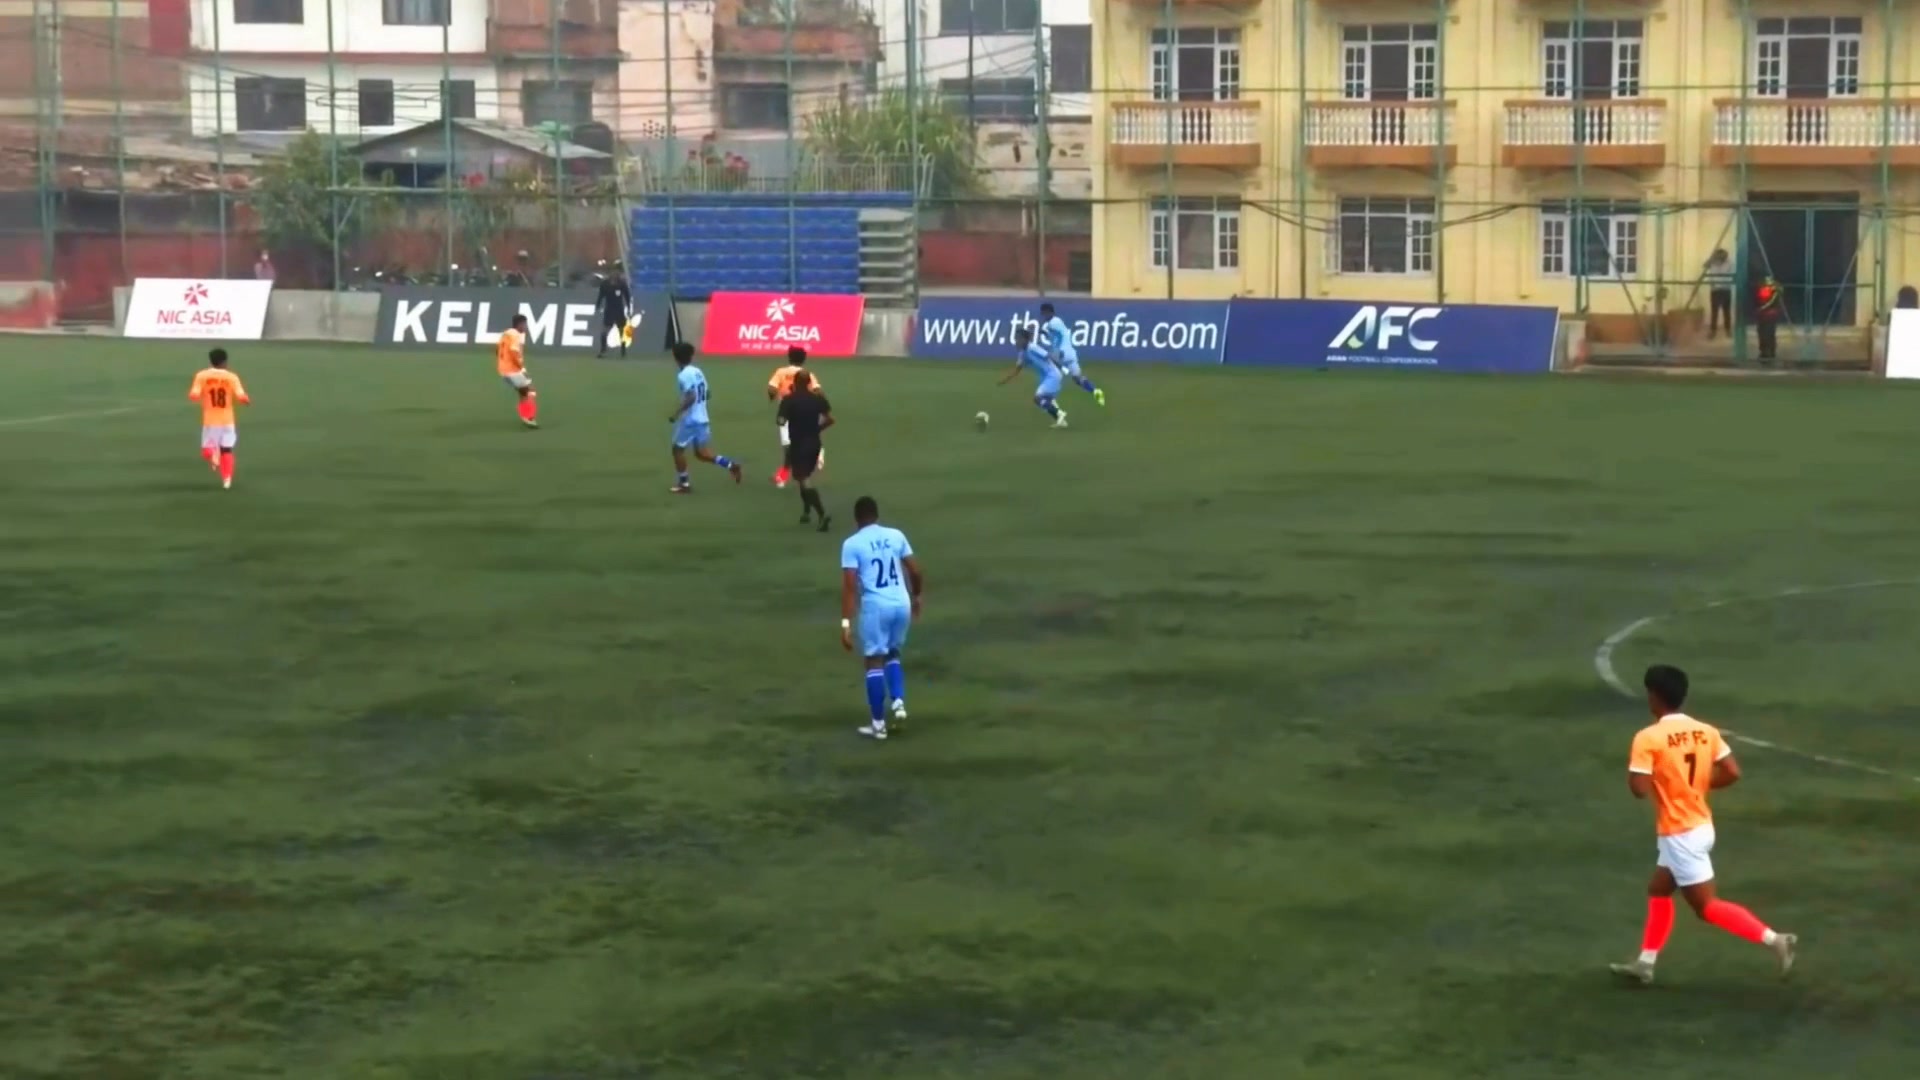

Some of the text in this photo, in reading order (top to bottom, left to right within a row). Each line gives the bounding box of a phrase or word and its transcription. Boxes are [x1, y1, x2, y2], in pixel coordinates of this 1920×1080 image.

[157, 309, 232, 325] NIC ASIA
[392, 299, 597, 348] KELME
[738, 324, 820, 342] NIC ASIA
[923, 310, 1218, 350] www.theanfa.com
[1327, 305, 1443, 351] AFC
[209, 388, 226, 408] 18
[871, 555, 899, 588] 24
[1684, 753, 1697, 787] 7
